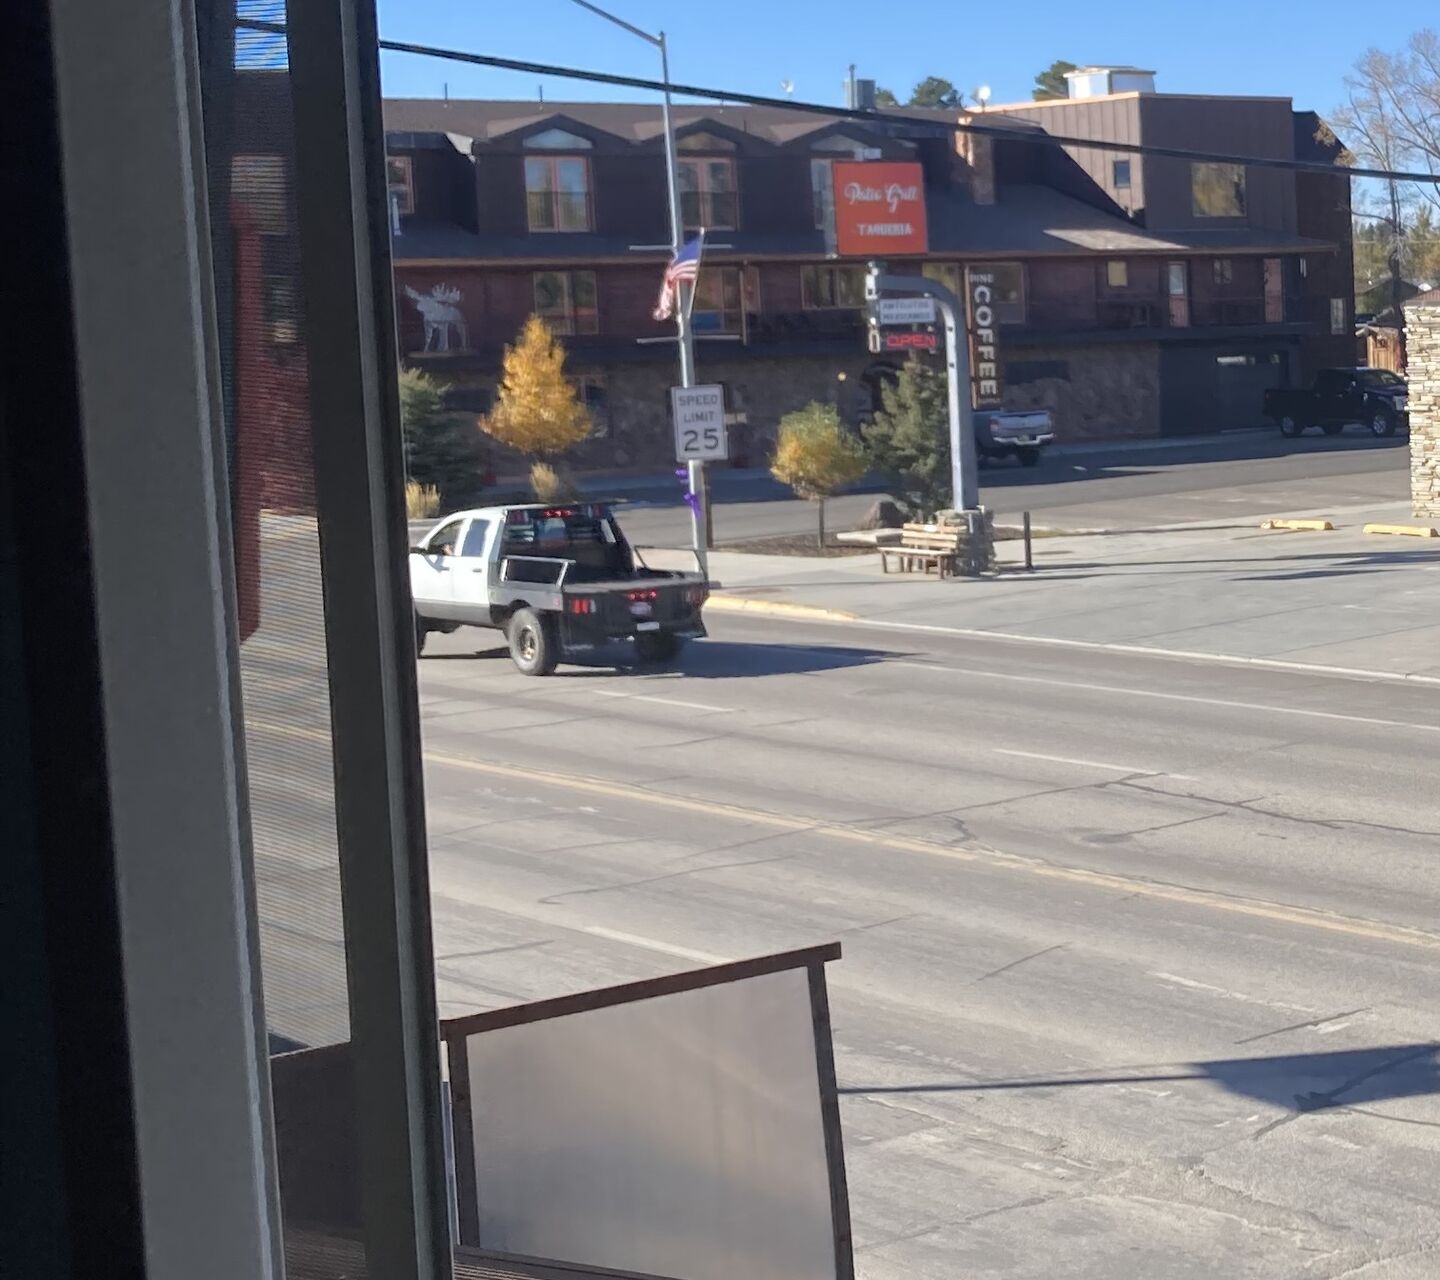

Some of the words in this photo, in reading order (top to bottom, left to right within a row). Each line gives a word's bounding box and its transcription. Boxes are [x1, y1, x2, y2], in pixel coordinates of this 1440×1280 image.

[886, 334, 936, 347] OPEN
[974, 285, 998, 395] COFFEE
[679, 394, 718, 406] SPEED
[684, 411, 714, 422] LIMIT
[684, 428, 719, 451] 25
